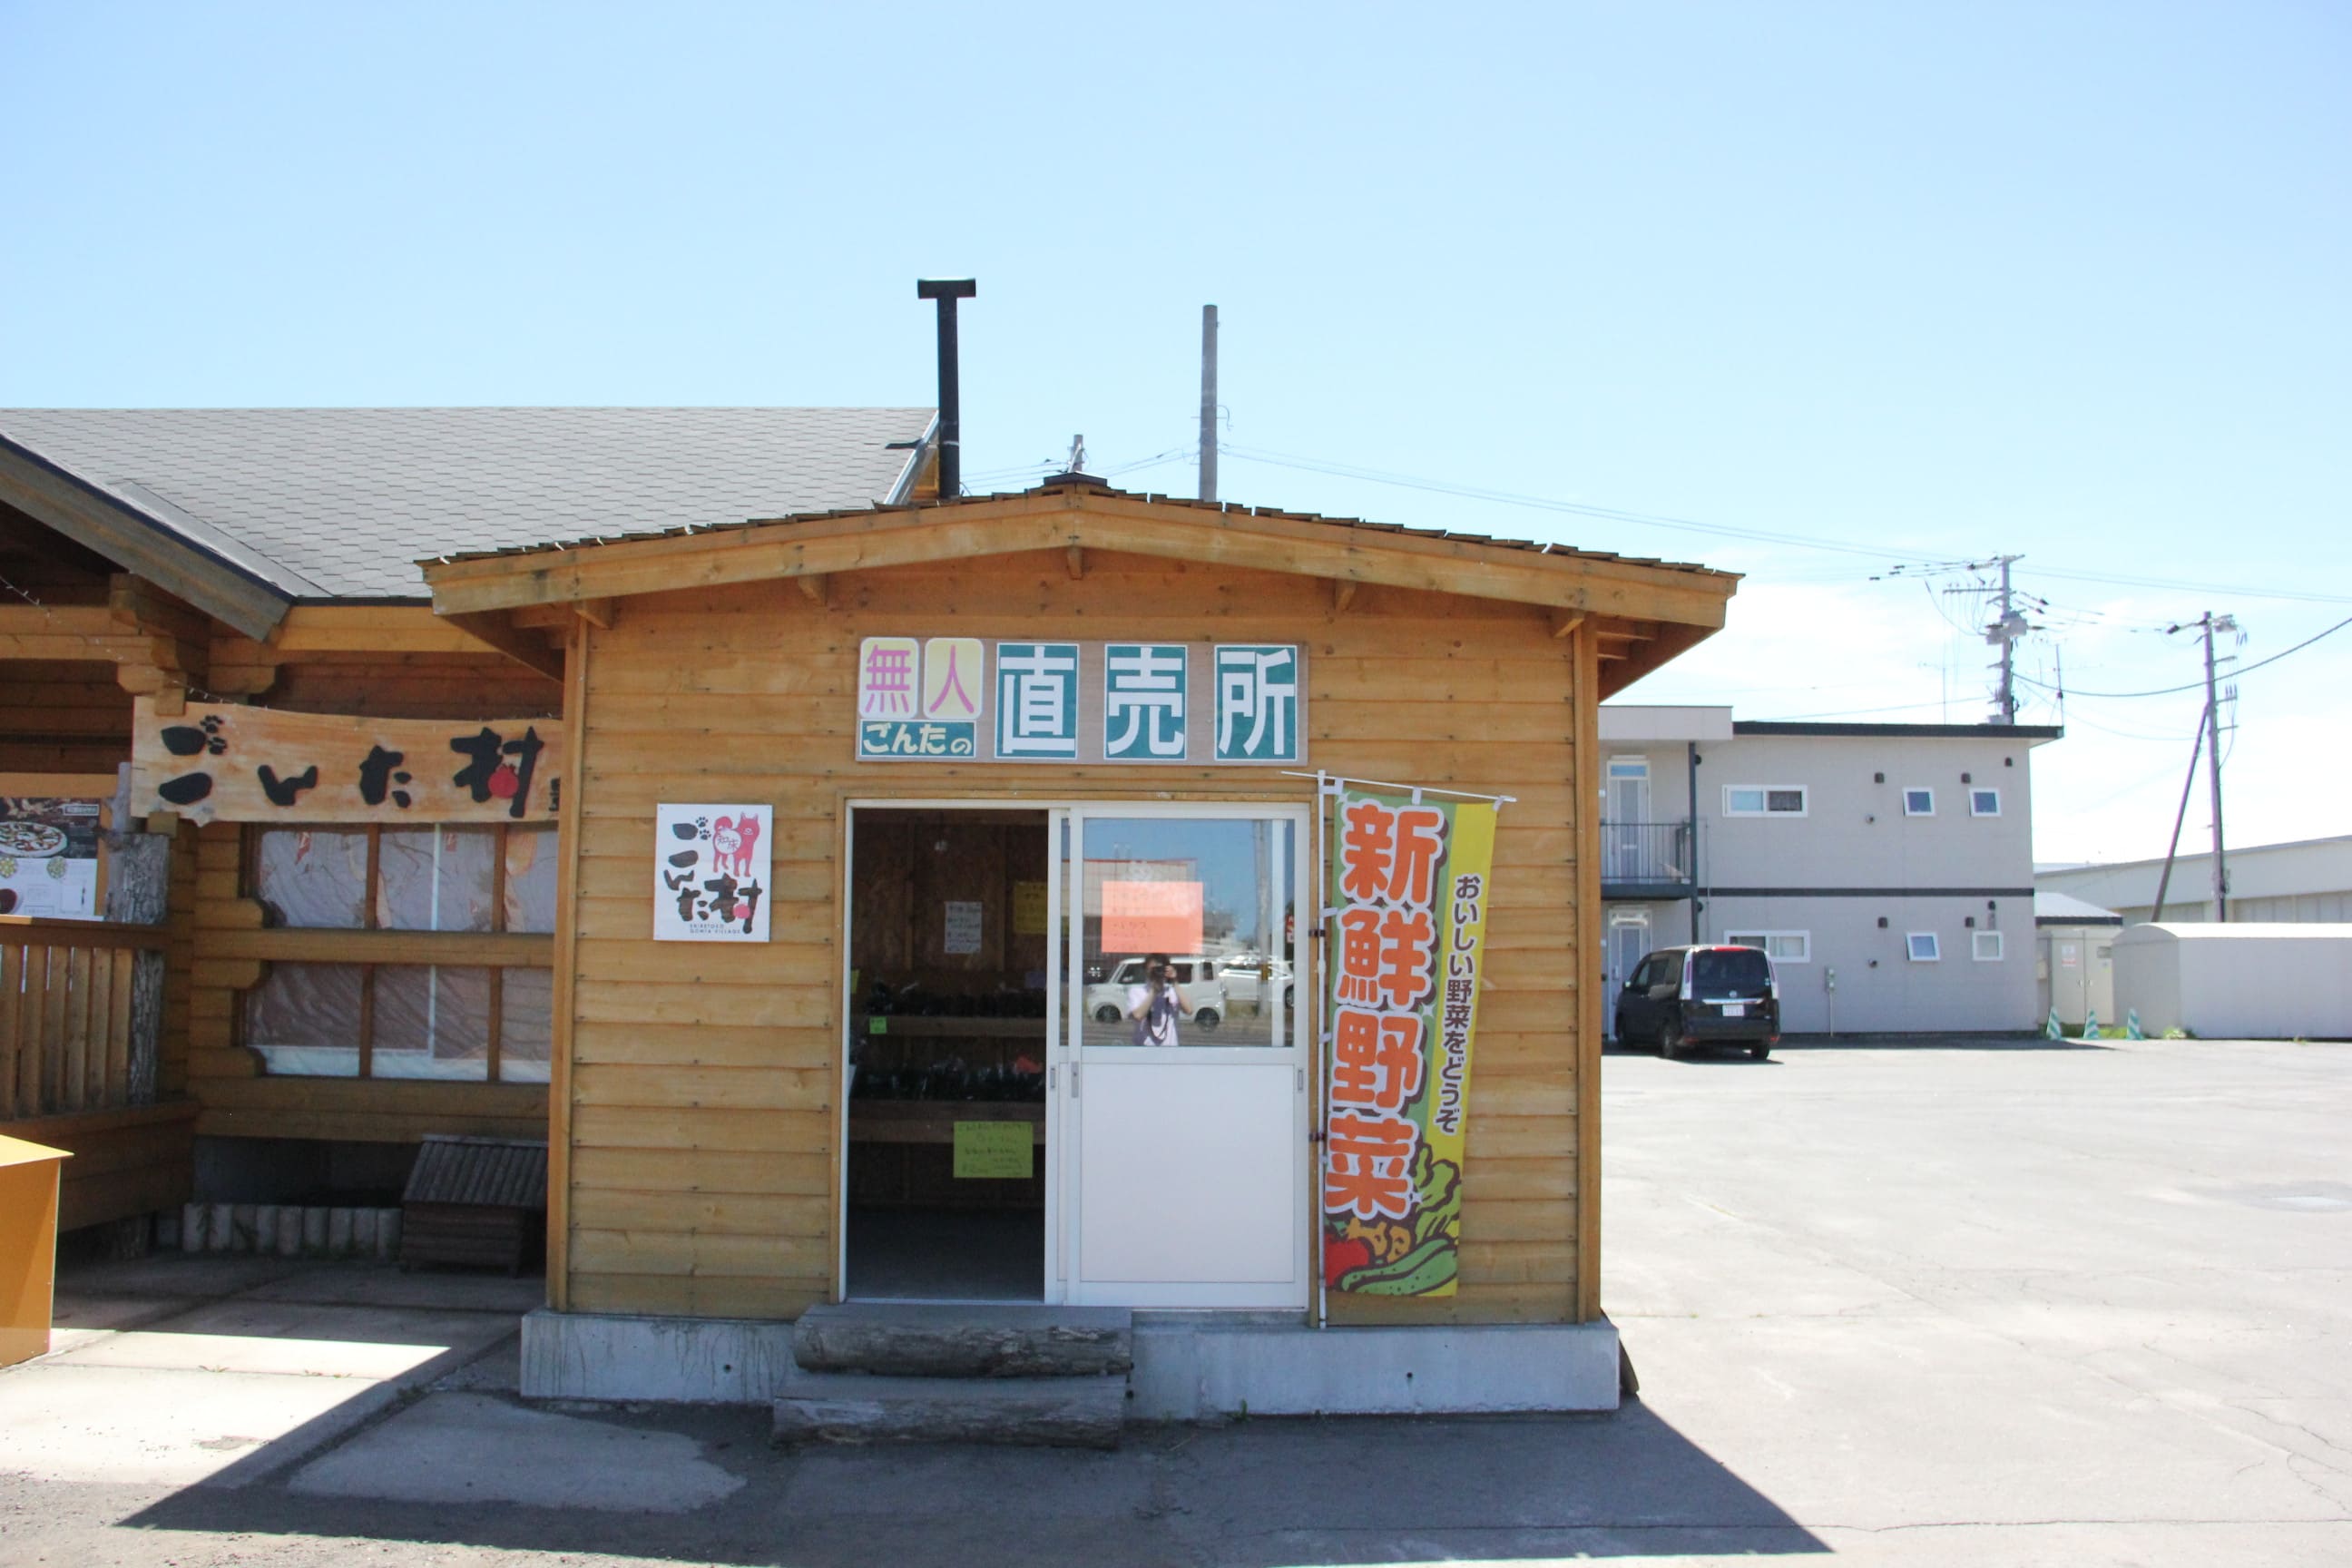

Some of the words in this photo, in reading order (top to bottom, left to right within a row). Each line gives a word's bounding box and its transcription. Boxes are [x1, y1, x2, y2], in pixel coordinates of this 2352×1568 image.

[865, 644, 975, 713] 無人
[999, 645, 1296, 756] 直売所
[1324, 803, 1441, 1216] 新鮮野菜
[1435, 876, 1481, 1133] おいしい野菜をどうぞ
